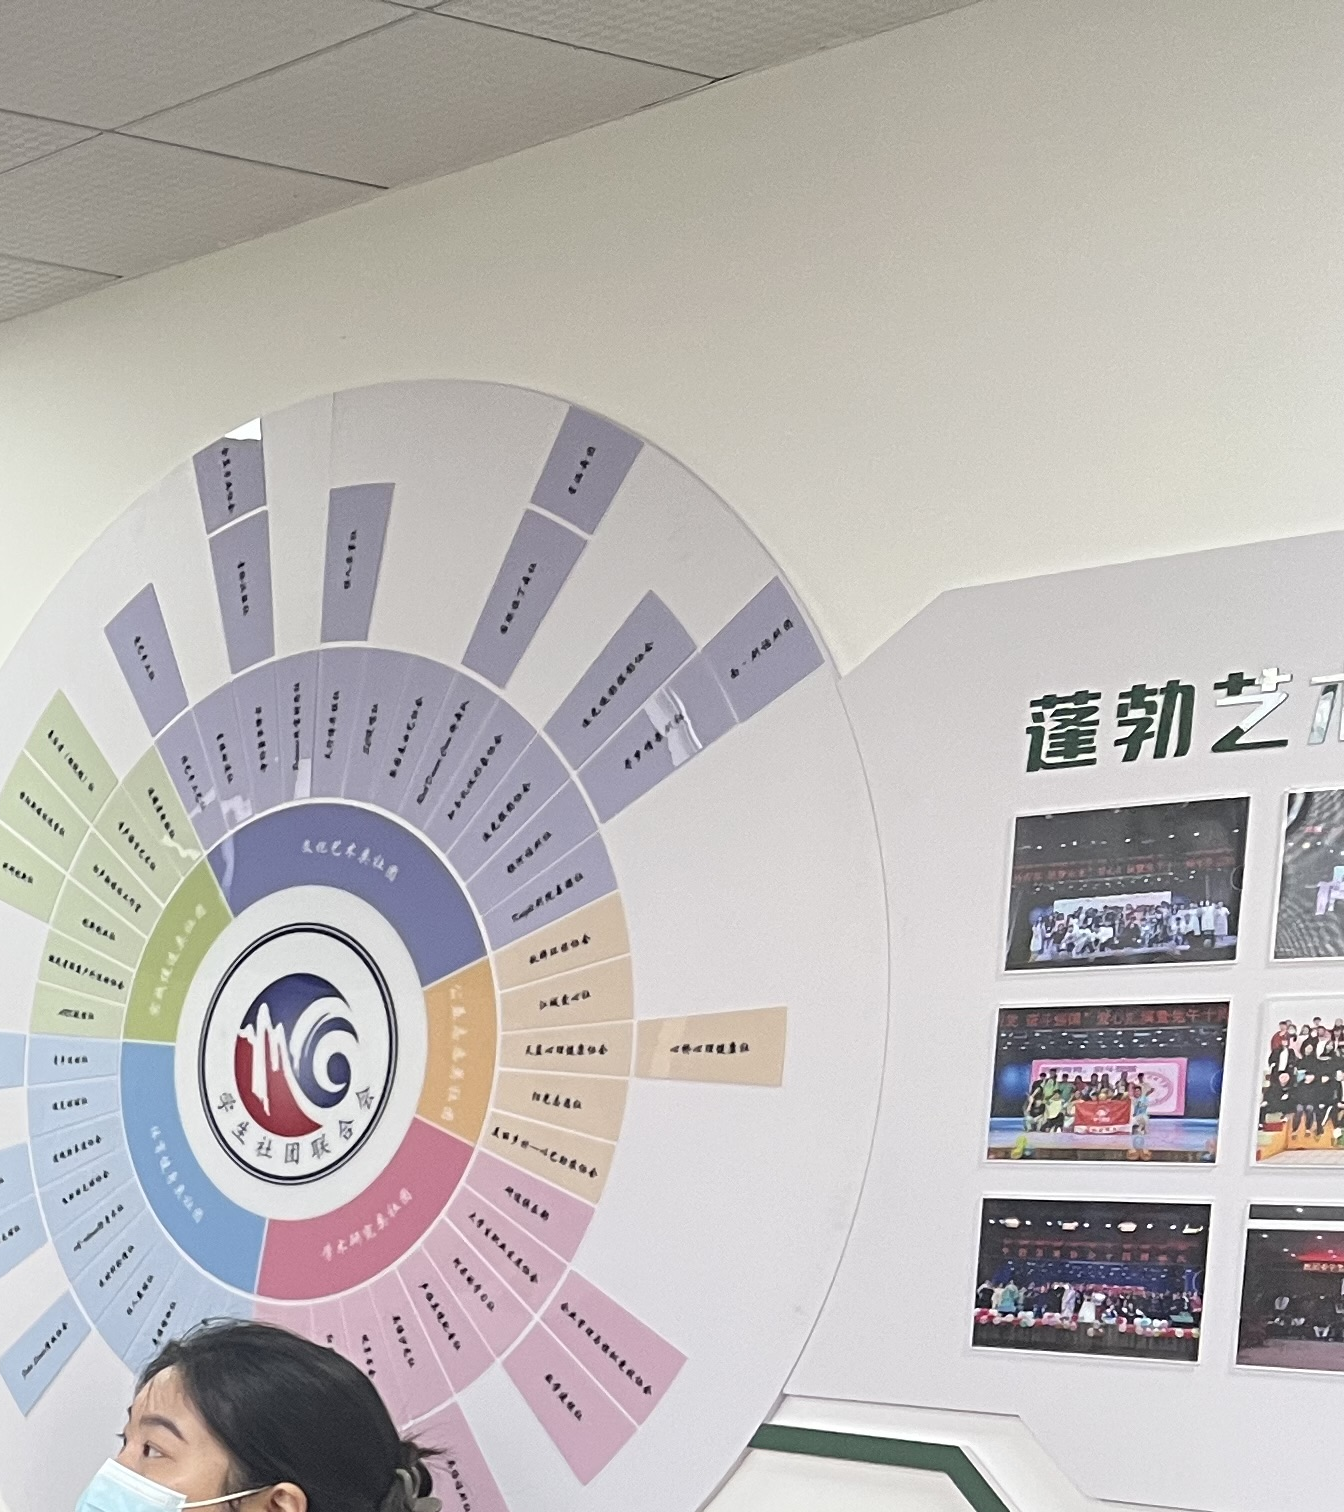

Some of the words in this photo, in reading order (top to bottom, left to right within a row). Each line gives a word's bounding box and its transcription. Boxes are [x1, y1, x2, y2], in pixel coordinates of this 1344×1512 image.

[217, 1087, 374, 1165] 学生社团联合会
